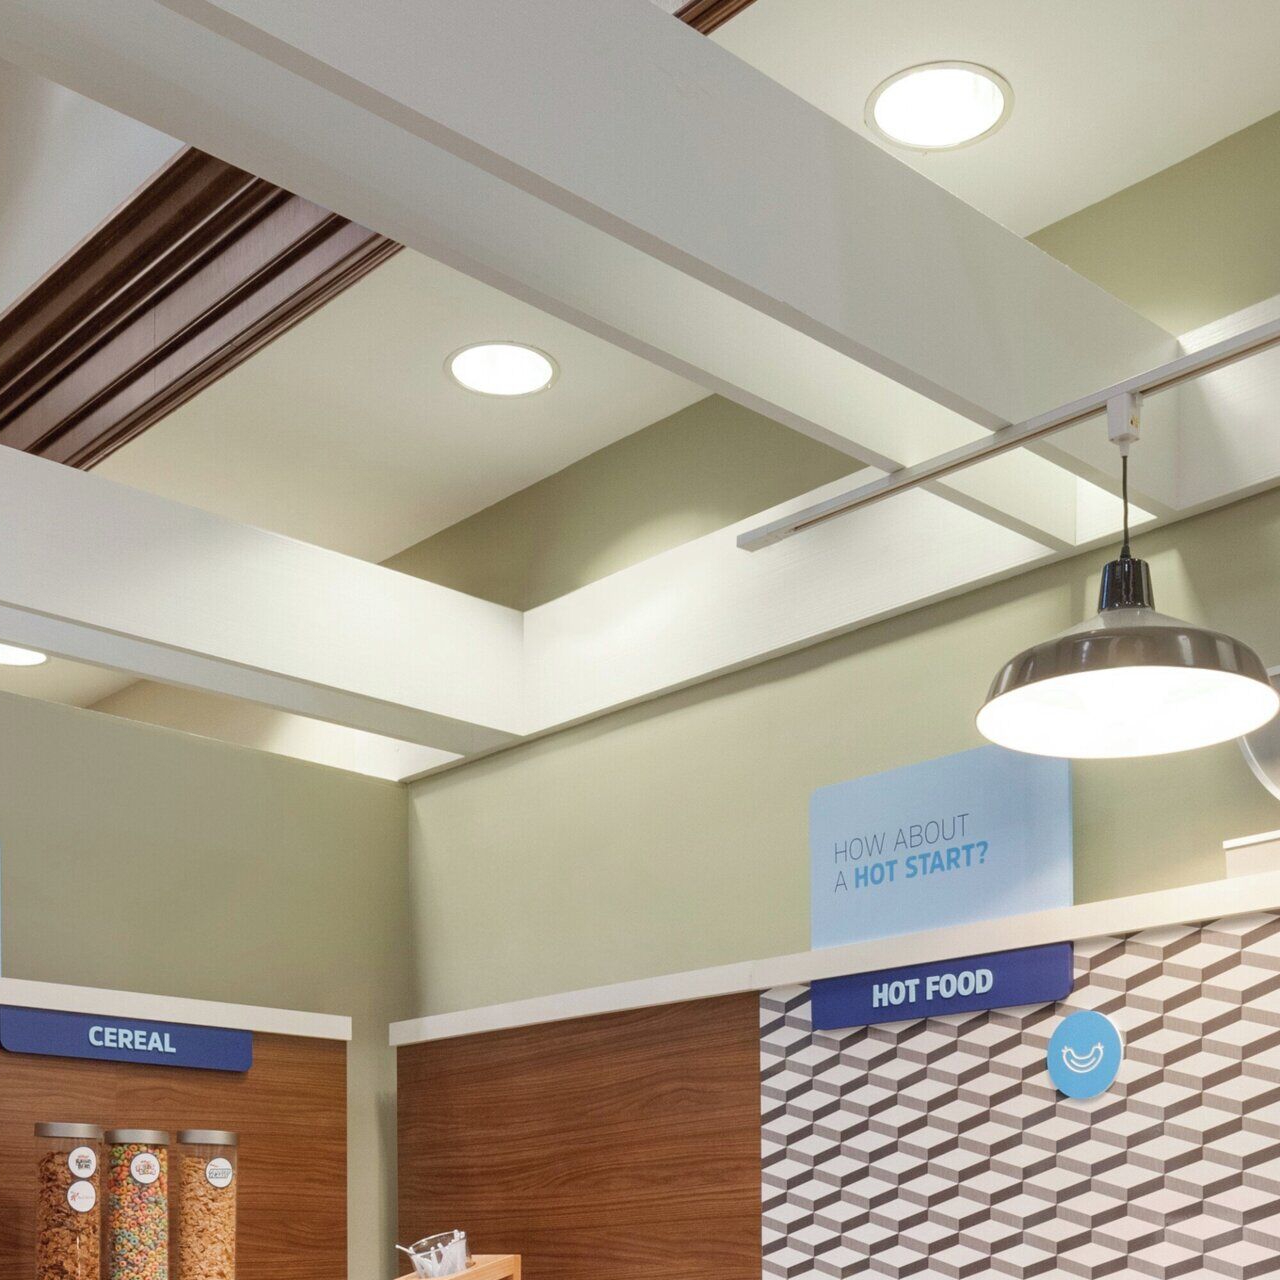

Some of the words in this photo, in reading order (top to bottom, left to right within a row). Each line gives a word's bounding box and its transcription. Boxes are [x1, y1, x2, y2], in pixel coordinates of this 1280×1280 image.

[834, 832, 886, 864] HOW
[893, 813, 969, 851] ABOUT
[834, 871, 848, 893] A
[854, 859, 898, 888] HOT
[905, 841, 988, 879] START?
[872, 978, 919, 1008] HOT
[925, 968, 994, 1000] FOOD
[88, 1024, 177, 1054] CEREAL
